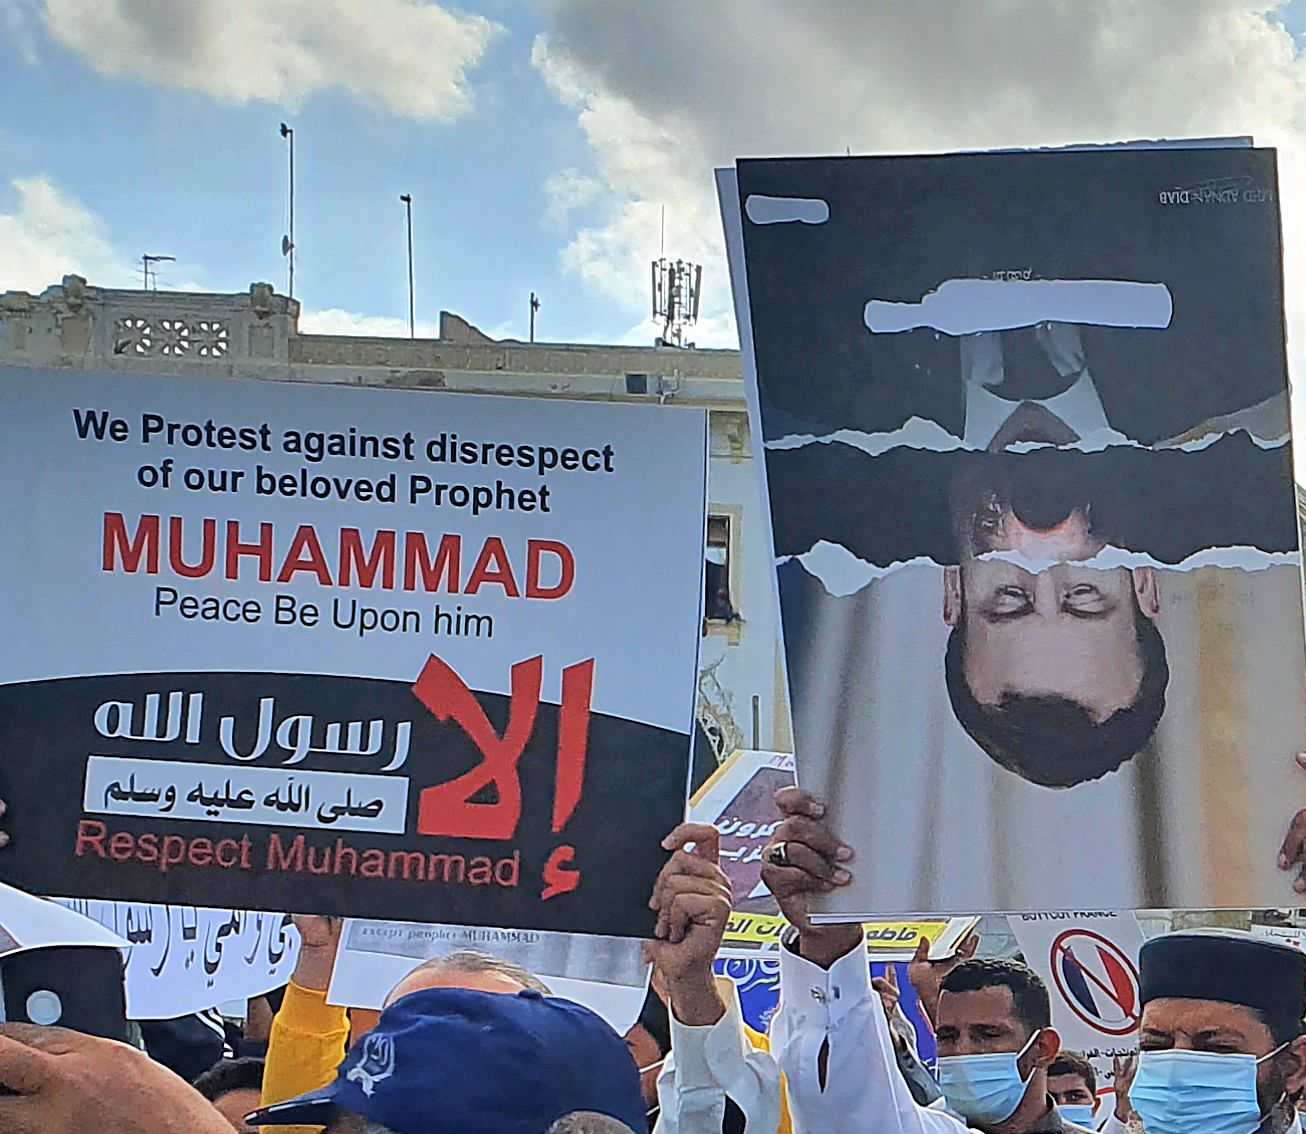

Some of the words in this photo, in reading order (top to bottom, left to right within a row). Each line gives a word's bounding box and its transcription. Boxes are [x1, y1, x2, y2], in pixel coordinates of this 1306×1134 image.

[74, 409, 129, 443] We
[141, 413, 271, 453] Protest
[283, 424, 415, 465] against
[427, 432, 616, 477] disrespect
[137, 459, 171, 489] of
[183, 468, 244, 494] our
[255, 467, 397, 503] beloved
[409, 476, 551, 516] Prophet
[102, 512, 576, 600] MUHAMMAD
[154, 587, 261, 624] Peace
[274, 595, 319, 628] Be
[332, 601, 420, 636] Upon
[433, 605, 495, 638] him
[93, 691, 205, 746] الله
[219, 698, 412, 769] رسول
[102, 772, 177, 813] وسلم
[187, 780, 255, 818] عليه
[262, 777, 311, 814] الله
[411, 653, 595, 901] إلا
[316, 791, 384, 823] صلى
[75, 820, 254, 871] Respect
[266, 834, 521, 888] Muhammad
